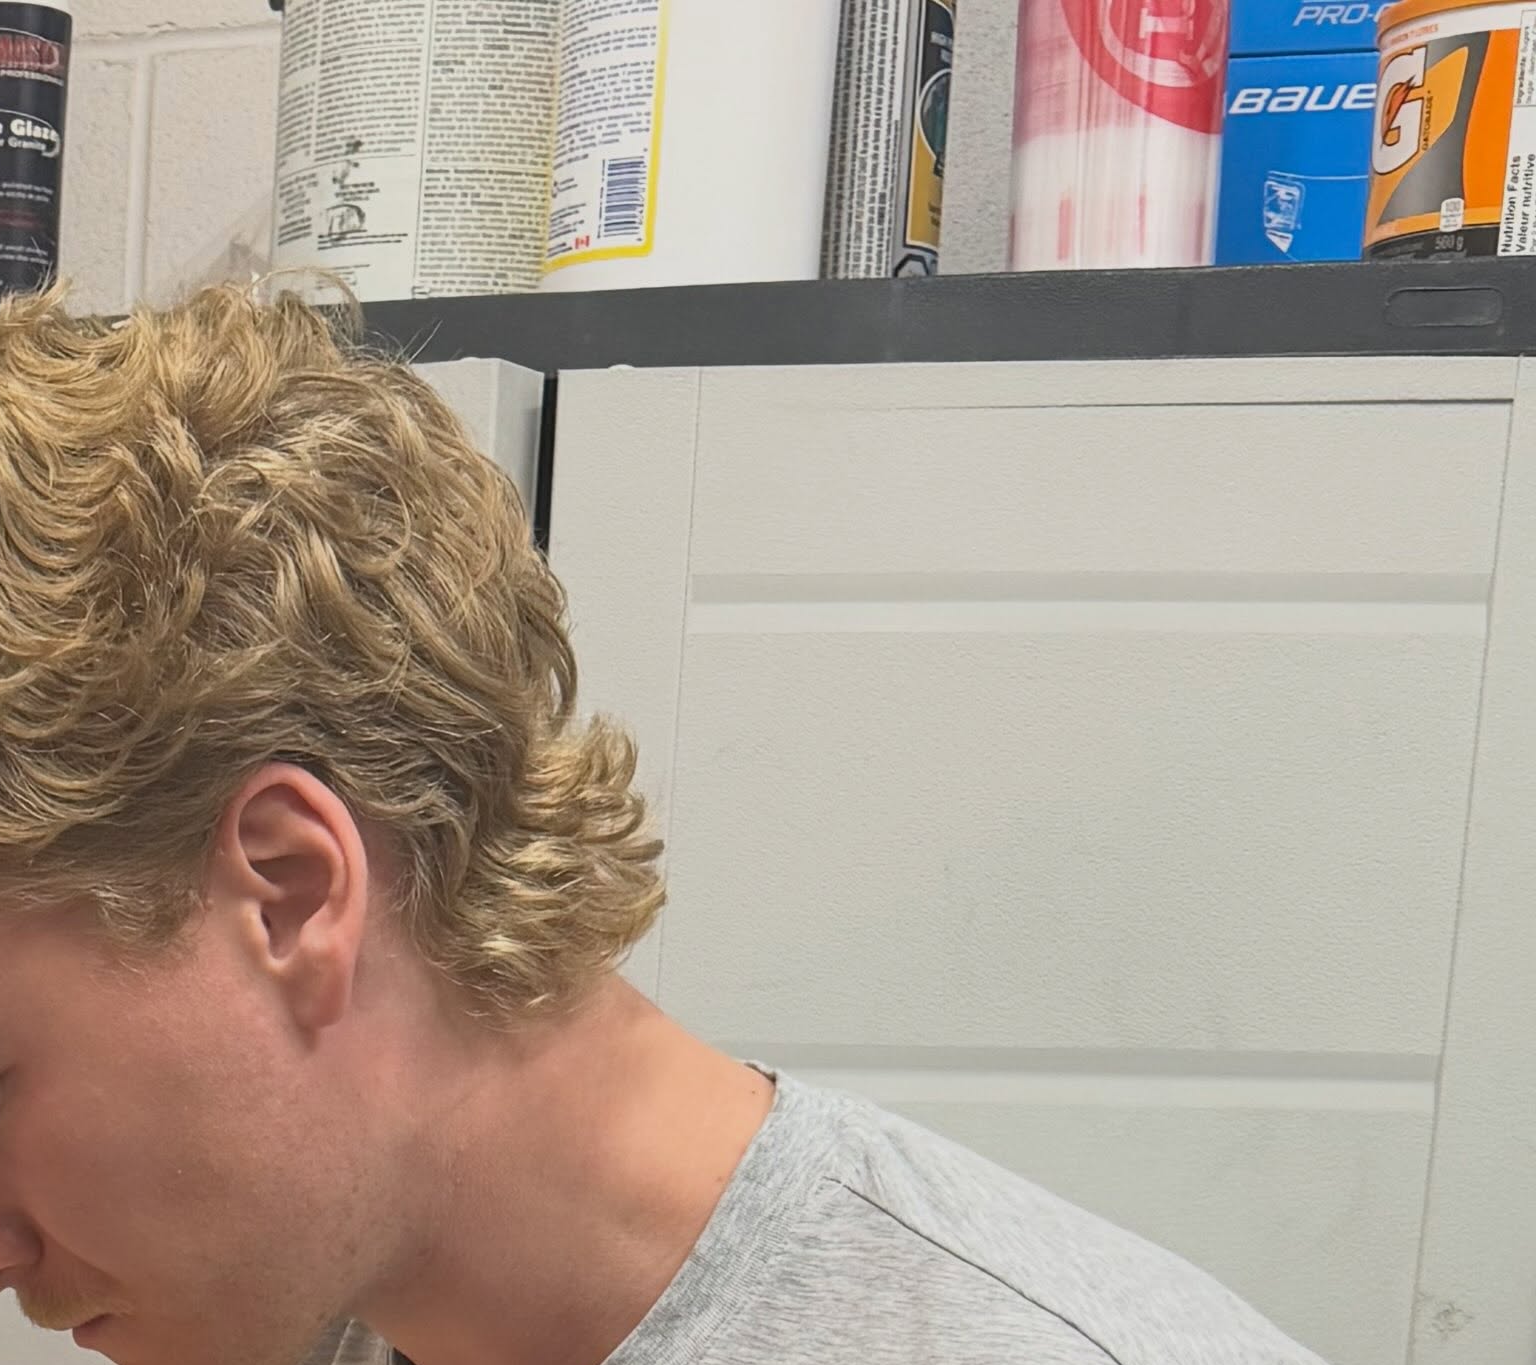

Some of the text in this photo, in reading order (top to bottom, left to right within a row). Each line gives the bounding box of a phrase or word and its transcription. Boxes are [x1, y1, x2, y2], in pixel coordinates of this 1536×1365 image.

[1292, 4, 1382, 26] PRO-
[1228, 84, 1378, 114] BAUE
[1421, 96, 1433, 150] GATORADE
[1500, 155, 1521, 253] Nutrition Facts
[1516, 153, 1535, 253] Valeur nutritive
